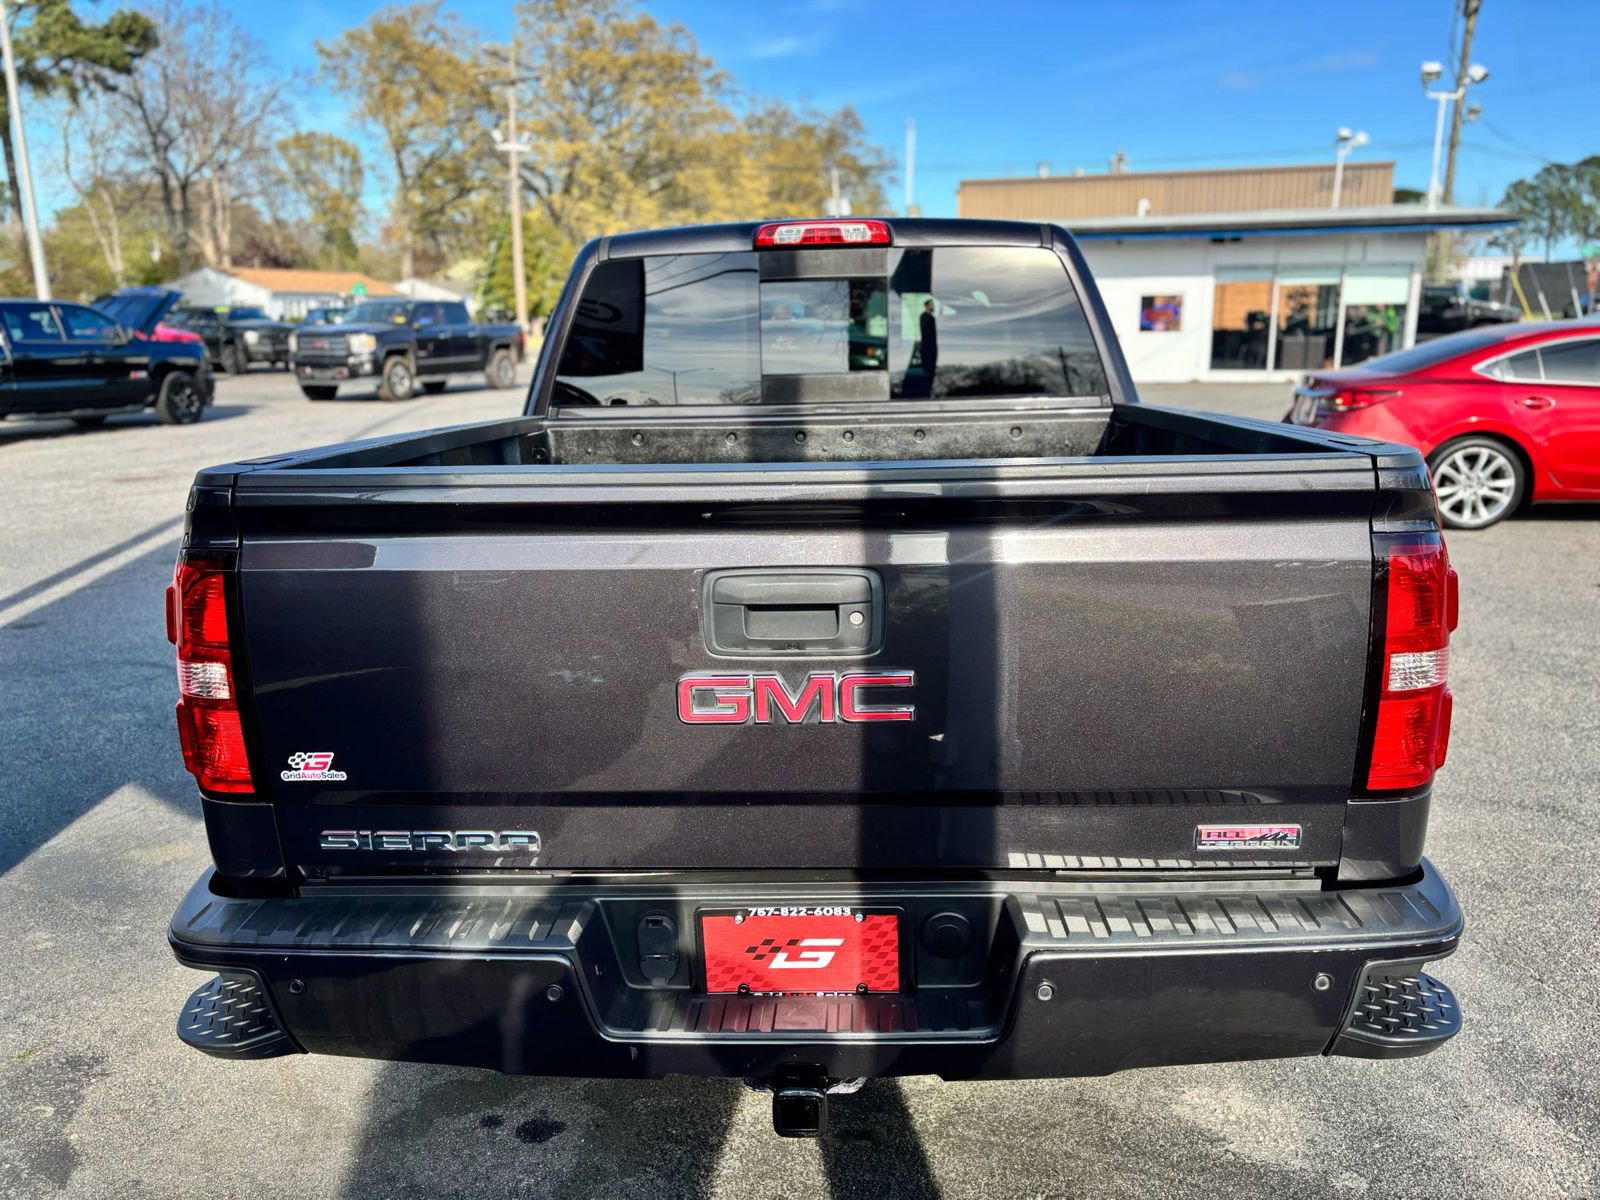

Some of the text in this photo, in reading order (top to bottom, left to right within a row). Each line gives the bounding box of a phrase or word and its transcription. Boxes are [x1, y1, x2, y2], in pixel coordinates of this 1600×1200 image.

[677, 670, 915, 724] GMC
[282, 771, 346, 780] GridAutoSales
[320, 830, 541, 851] SIERRA
